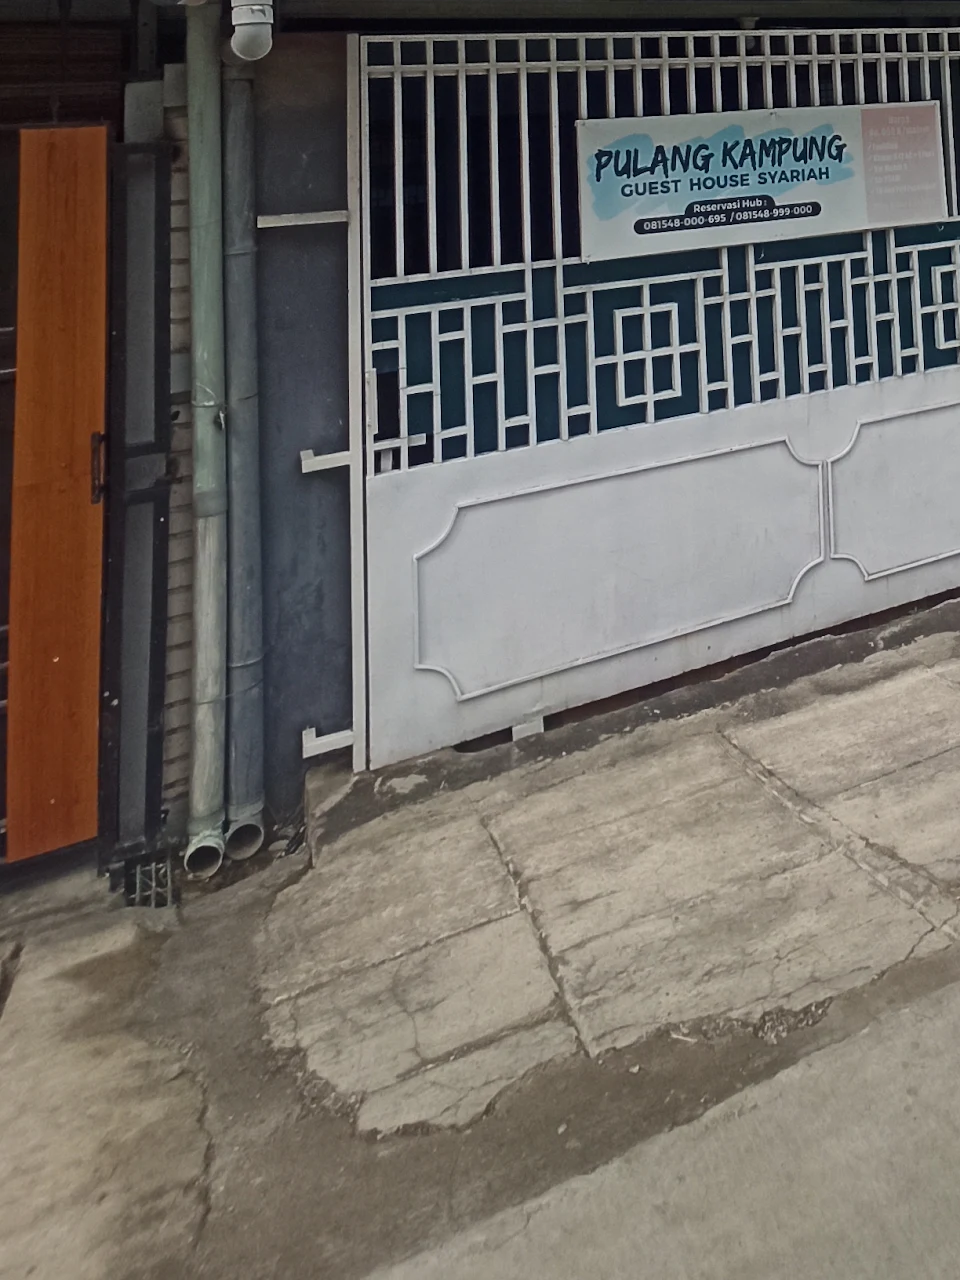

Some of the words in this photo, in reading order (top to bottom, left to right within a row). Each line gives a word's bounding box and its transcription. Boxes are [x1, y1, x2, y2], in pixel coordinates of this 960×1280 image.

[594, 143, 714, 183] PULANG
[721, 134, 847, 171] KAMPUNG
[620, 179, 682, 198] GUEST
[689, 173, 750, 192] HOUSE
[757, 166, 830, 186] SYARIAH
[693, 199, 741, 213] Reservasi
[643, 213, 727, 231] 081548-000-695
